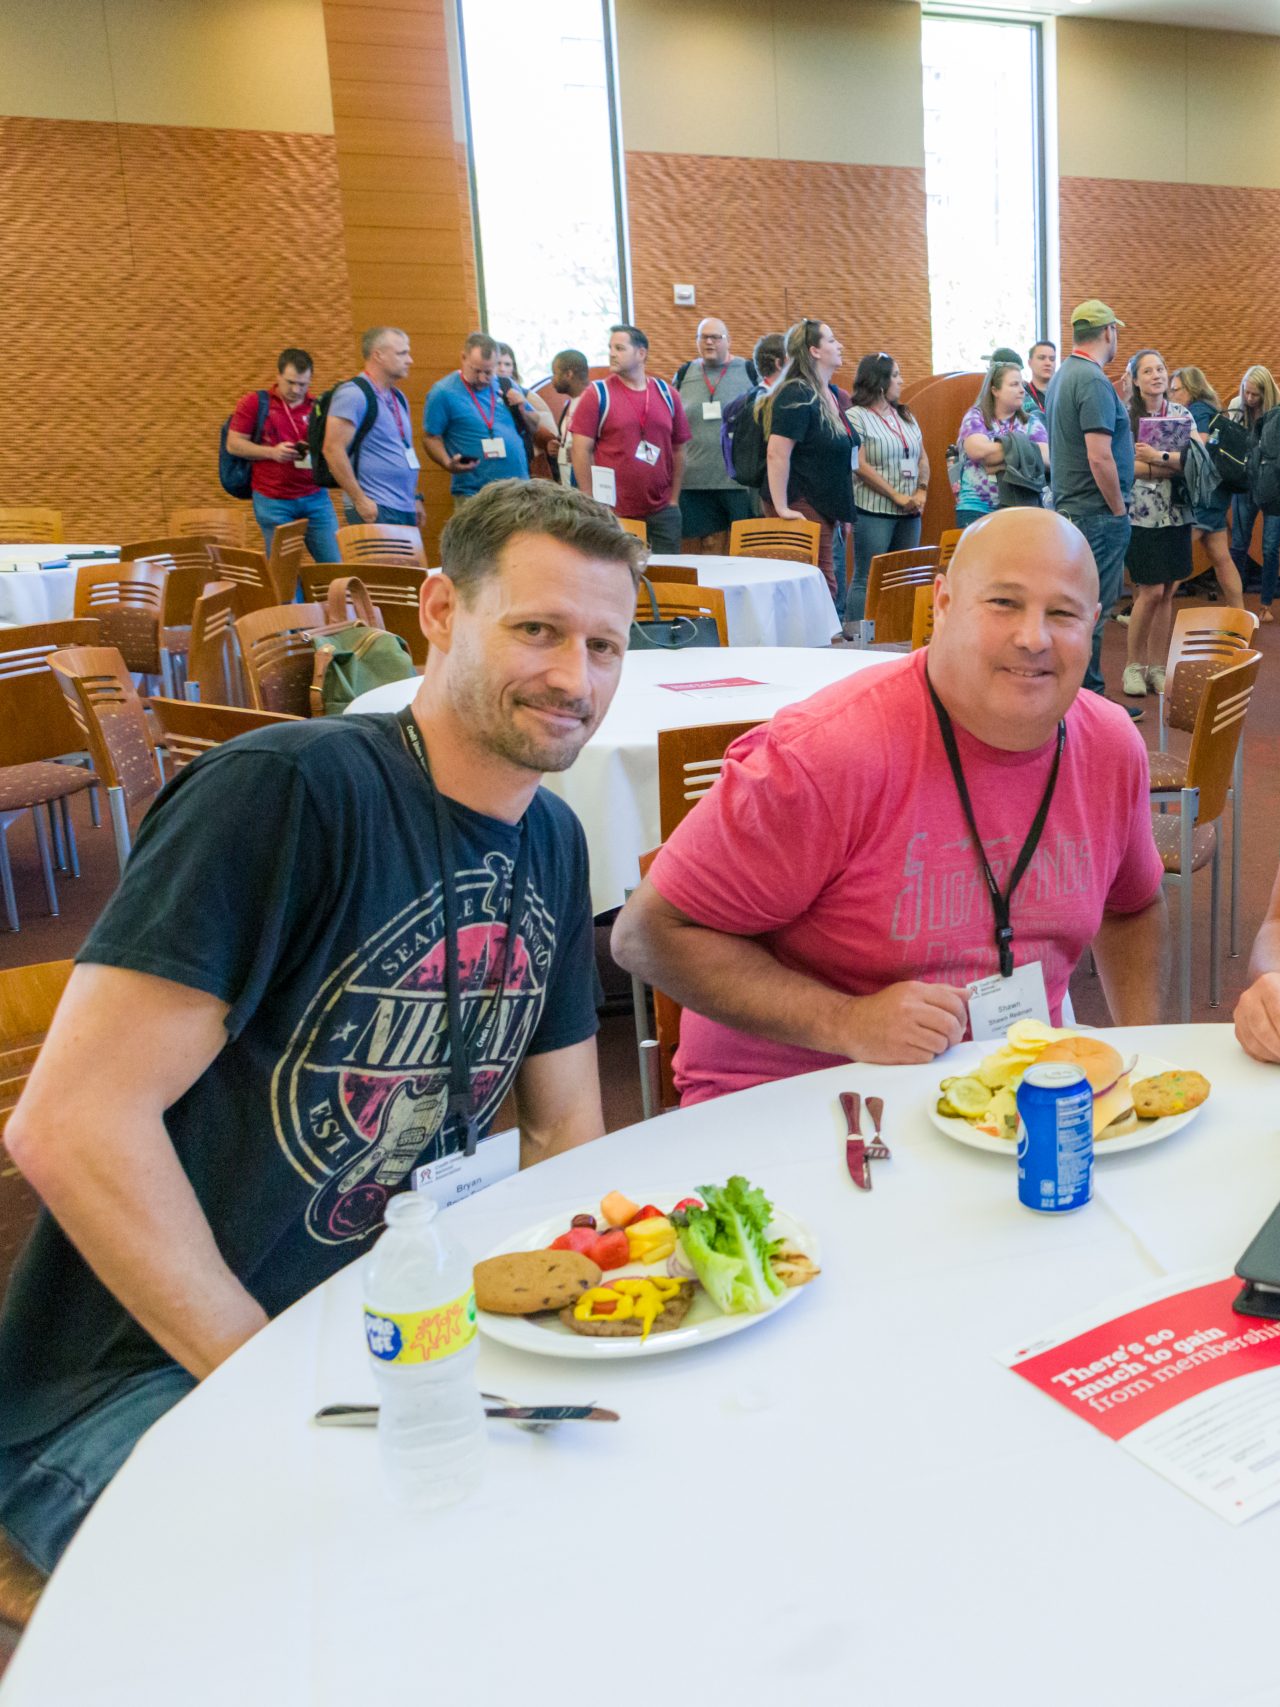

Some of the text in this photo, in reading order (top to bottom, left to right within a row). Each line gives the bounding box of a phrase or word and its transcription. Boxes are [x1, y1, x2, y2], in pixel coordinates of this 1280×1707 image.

[309, 1098, 351, 1160] EST.
[456, 1177, 482, 1194] Bryan
[1051, 1343, 1145, 1388] There's
[1145, 1328, 1176, 1347] so
[1071, 1327, 1228, 1401] much to gain
[1088, 1379, 1155, 1413] from
